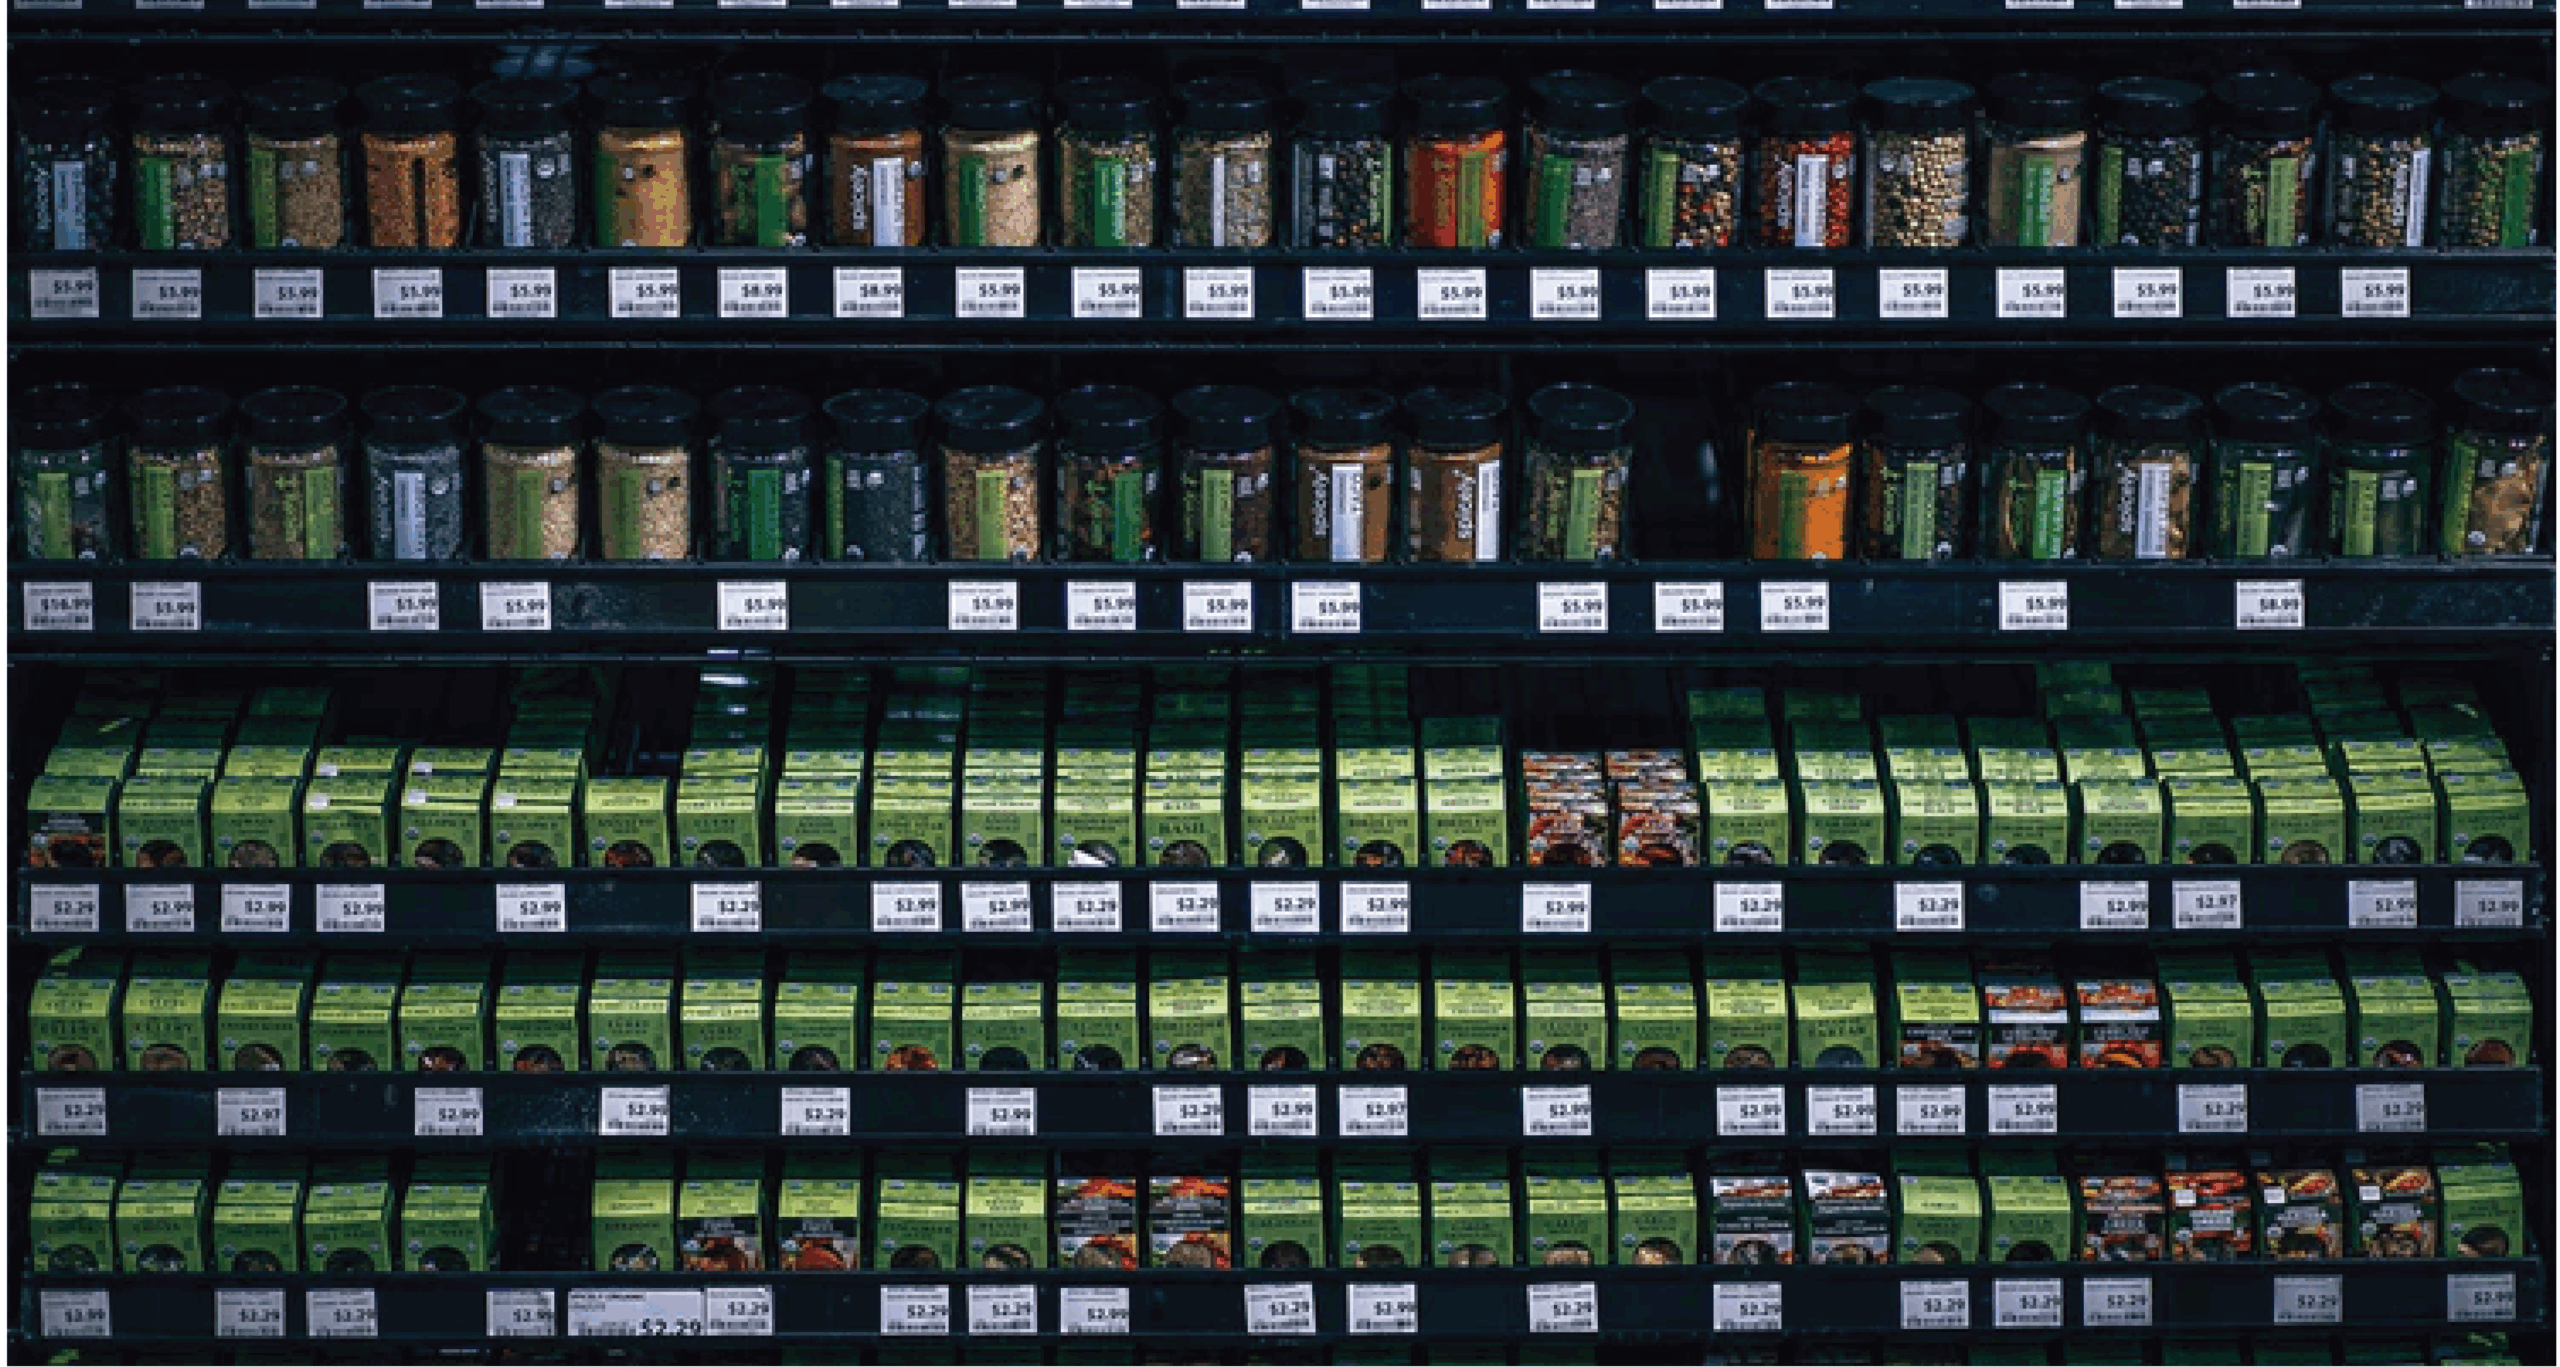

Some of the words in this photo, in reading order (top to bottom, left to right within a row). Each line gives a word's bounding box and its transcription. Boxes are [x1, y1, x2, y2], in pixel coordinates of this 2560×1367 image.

[852, 164, 868, 230] spicely
[1776, 161, 1794, 227] spicely
[159, 285, 200, 300] $5.99
[278, 285, 319, 300] $5.99
[400, 285, 441, 300] $5.99
[510, 283, 551, 298] $5.99
[636, 283, 677, 298] $5.99
[741, 283, 782, 298] $8.99
[860, 283, 901, 298] $8.99
[979, 282, 1020, 297] $5.99
[1098, 282, 1139, 297] $5.99
[1209, 283, 1250, 298] $5.99
[1330, 284, 1371, 299] $5.99
[1441, 285, 1482, 300] $5.99
[1557, 285, 1598, 300] $5.99
[1671, 284, 1712, 299] $5.99
[1792, 284, 1833, 299] $5.99
[1903, 282, 1944, 297] $5.99
[2022, 283, 2063, 298] $5.99
[2137, 282, 2178, 297] $5.99
[2253, 283, 2294, 298] $5.99
[2364, 282, 2405, 297] $5.99
[1313, 472, 1329, 537] spicely
[1454, 475, 1473, 540] spicely
[2118, 468, 2137, 534] spicely
[155, 599, 196, 614] $5.99
[396, 596, 437, 611] $5.99
[505, 598, 546, 613] $5.99
[745, 597, 786, 612] $5.99
[973, 596, 1014, 611] $5.99
[1094, 596, 1135, 611] $5.99
[1207, 598, 1248, 613] $5.99
[1319, 600, 1360, 615] $5.99
[1562, 598, 1603, 613] $5.99
[1682, 597, 1723, 612] $5.99
[1784, 595, 1825, 610] $5.99
[2026, 596, 2067, 611] $5.99
[2259, 596, 2300, 611] $8.99
[1158, 820, 1206, 836] BASIL
